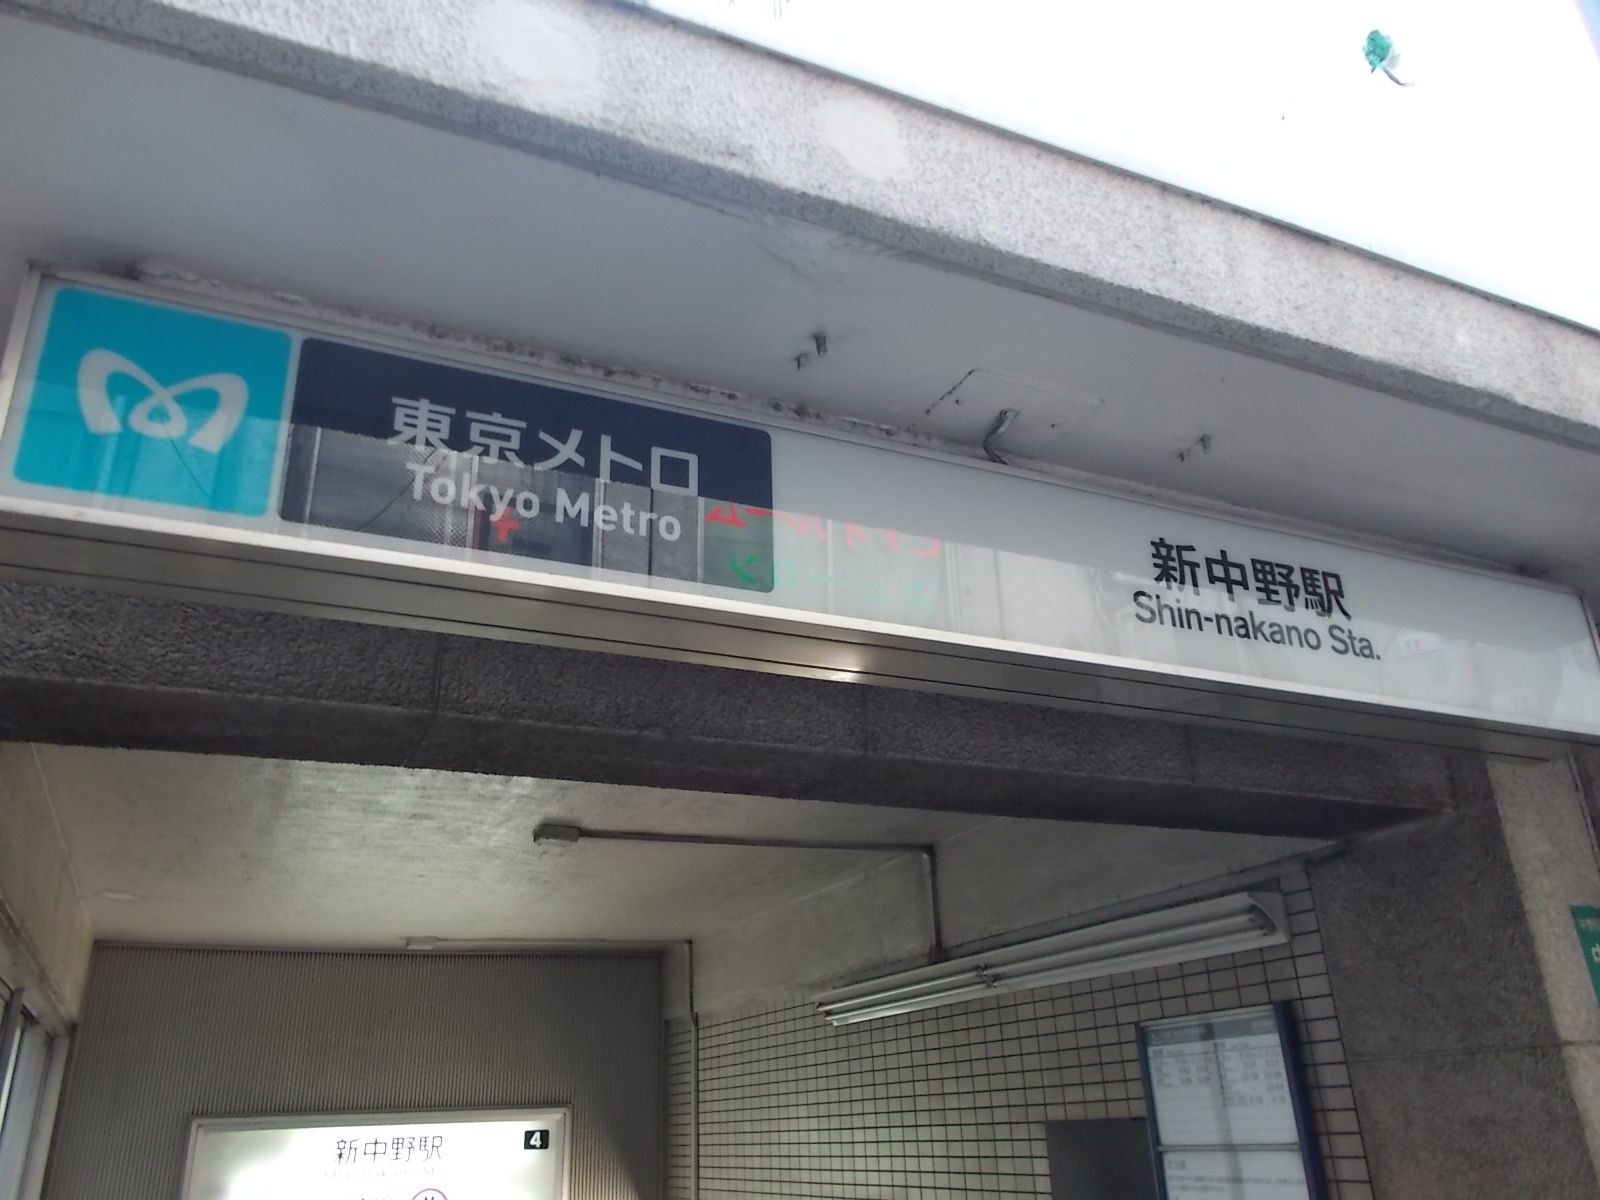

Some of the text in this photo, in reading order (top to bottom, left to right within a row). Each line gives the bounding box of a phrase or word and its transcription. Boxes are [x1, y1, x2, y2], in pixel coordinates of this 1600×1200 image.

[387, 397, 699, 497] 東京メトロ
[405, 462, 541, 522] Tokyo
[555, 487, 682, 542] Metro
[1150, 537, 1352, 621] 新中野駅
[1132, 590, 1382, 661] Shin-nakano Sta.
[335, 1135, 443, 1165] 新中野駅
[528, 1131, 543, 1148] 4
